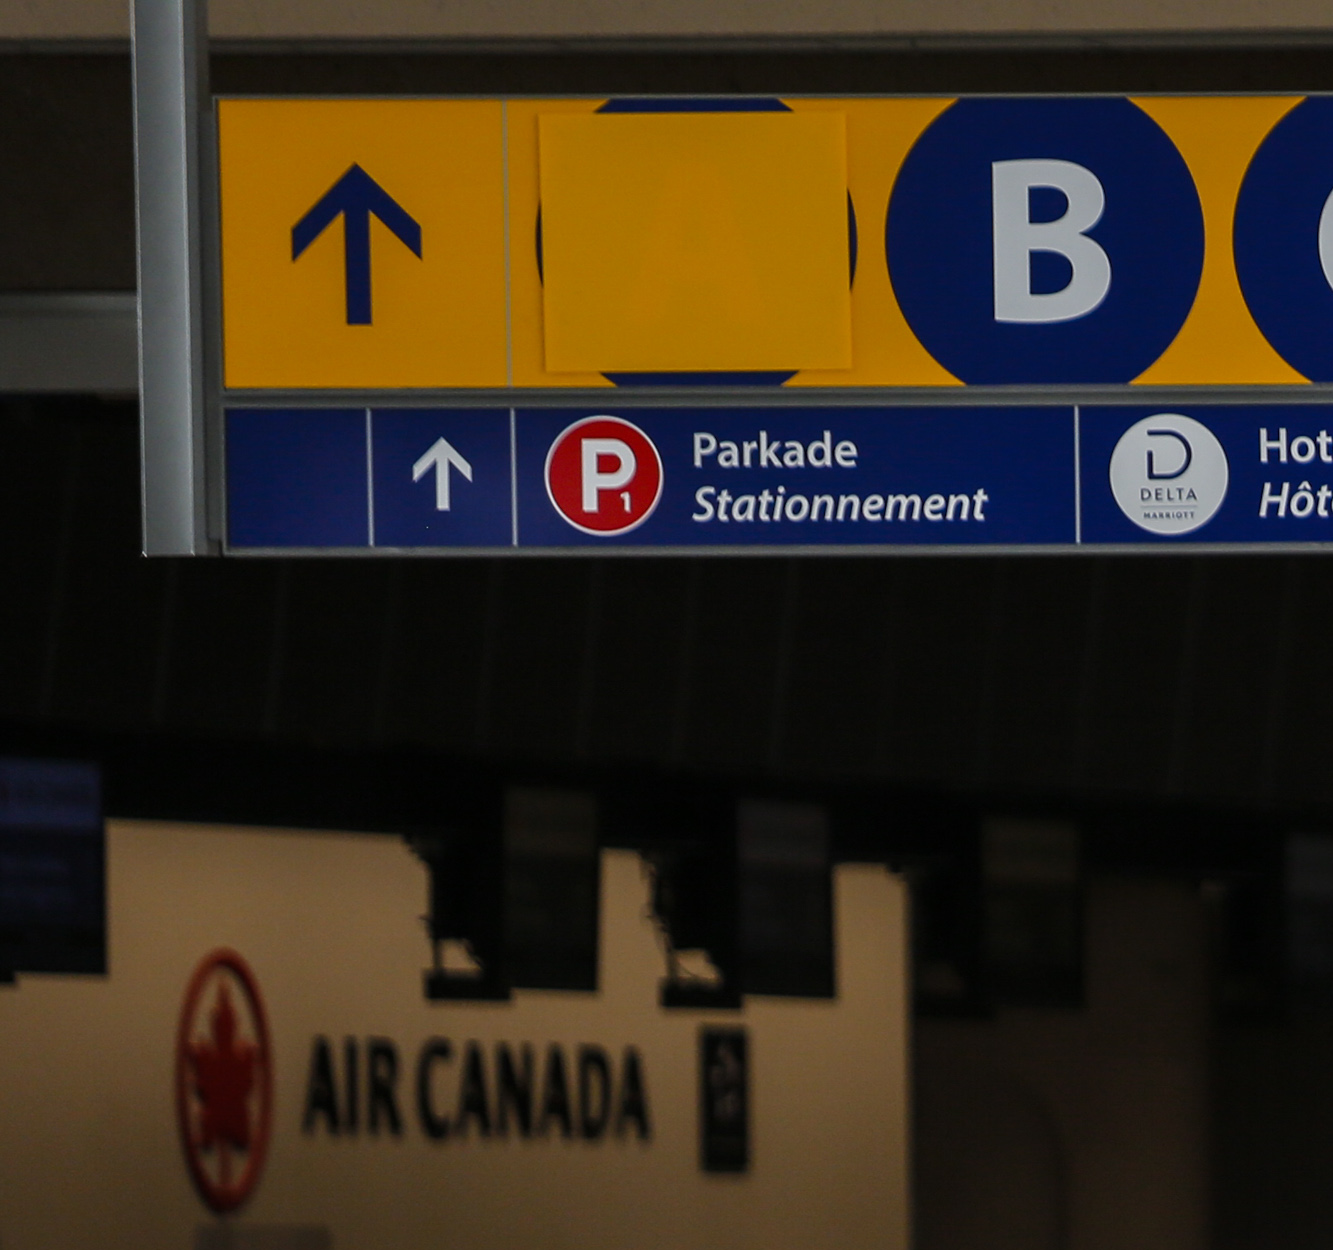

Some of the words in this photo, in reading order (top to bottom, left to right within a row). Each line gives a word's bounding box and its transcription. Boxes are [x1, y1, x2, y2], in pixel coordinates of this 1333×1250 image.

[991, 158, 1112, 323] B
[693, 430, 858, 468] Parkade
[692, 486, 988, 523] Stationnement
[1140, 487, 1198, 502] DELTA
[1143, 511, 1195, 520] MARRIOTT
[304, 1034, 404, 1136] AIR
[418, 1035, 650, 1142] CANADA
